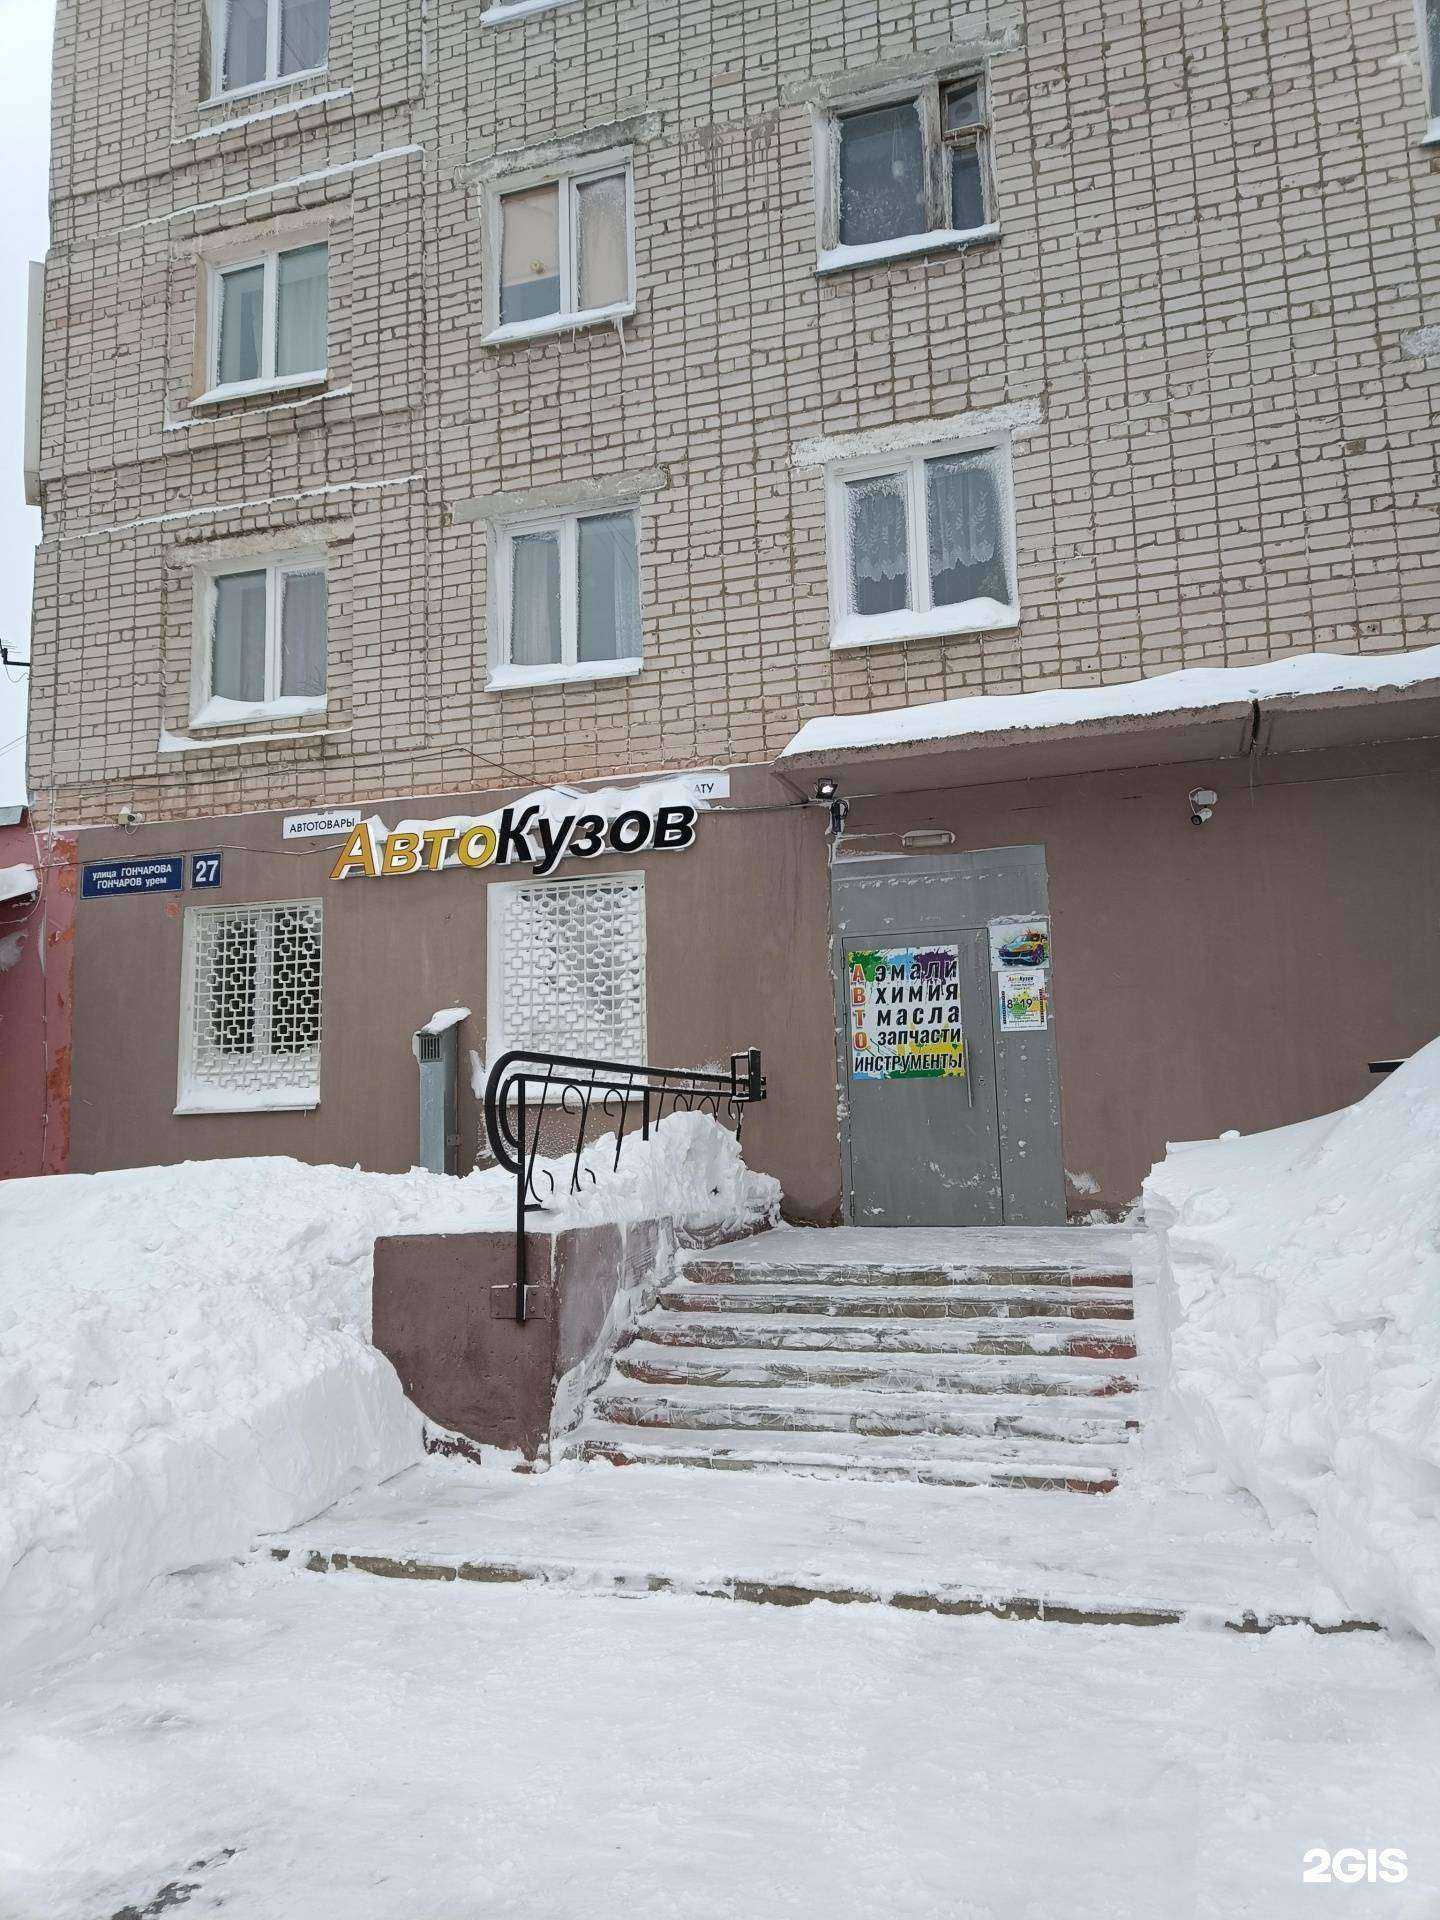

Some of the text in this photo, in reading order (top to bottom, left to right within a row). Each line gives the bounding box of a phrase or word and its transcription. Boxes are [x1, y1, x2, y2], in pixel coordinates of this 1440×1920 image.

[289, 818, 355, 833] АВТОТОВАРЫ
[92, 863, 172, 881] улица ГОНЧАРОВА
[195, 860, 219, 883] 27
[97, 876, 167, 889] ГОНЧАРОВ урем
[874, 961, 958, 983] эмали
[875, 983, 958, 1004] химия
[876, 1005, 960, 1027] масла
[877, 1028, 961, 1046] запчасти
[854, 1052, 962, 1073] ИНСТРУМЕНТЫ
